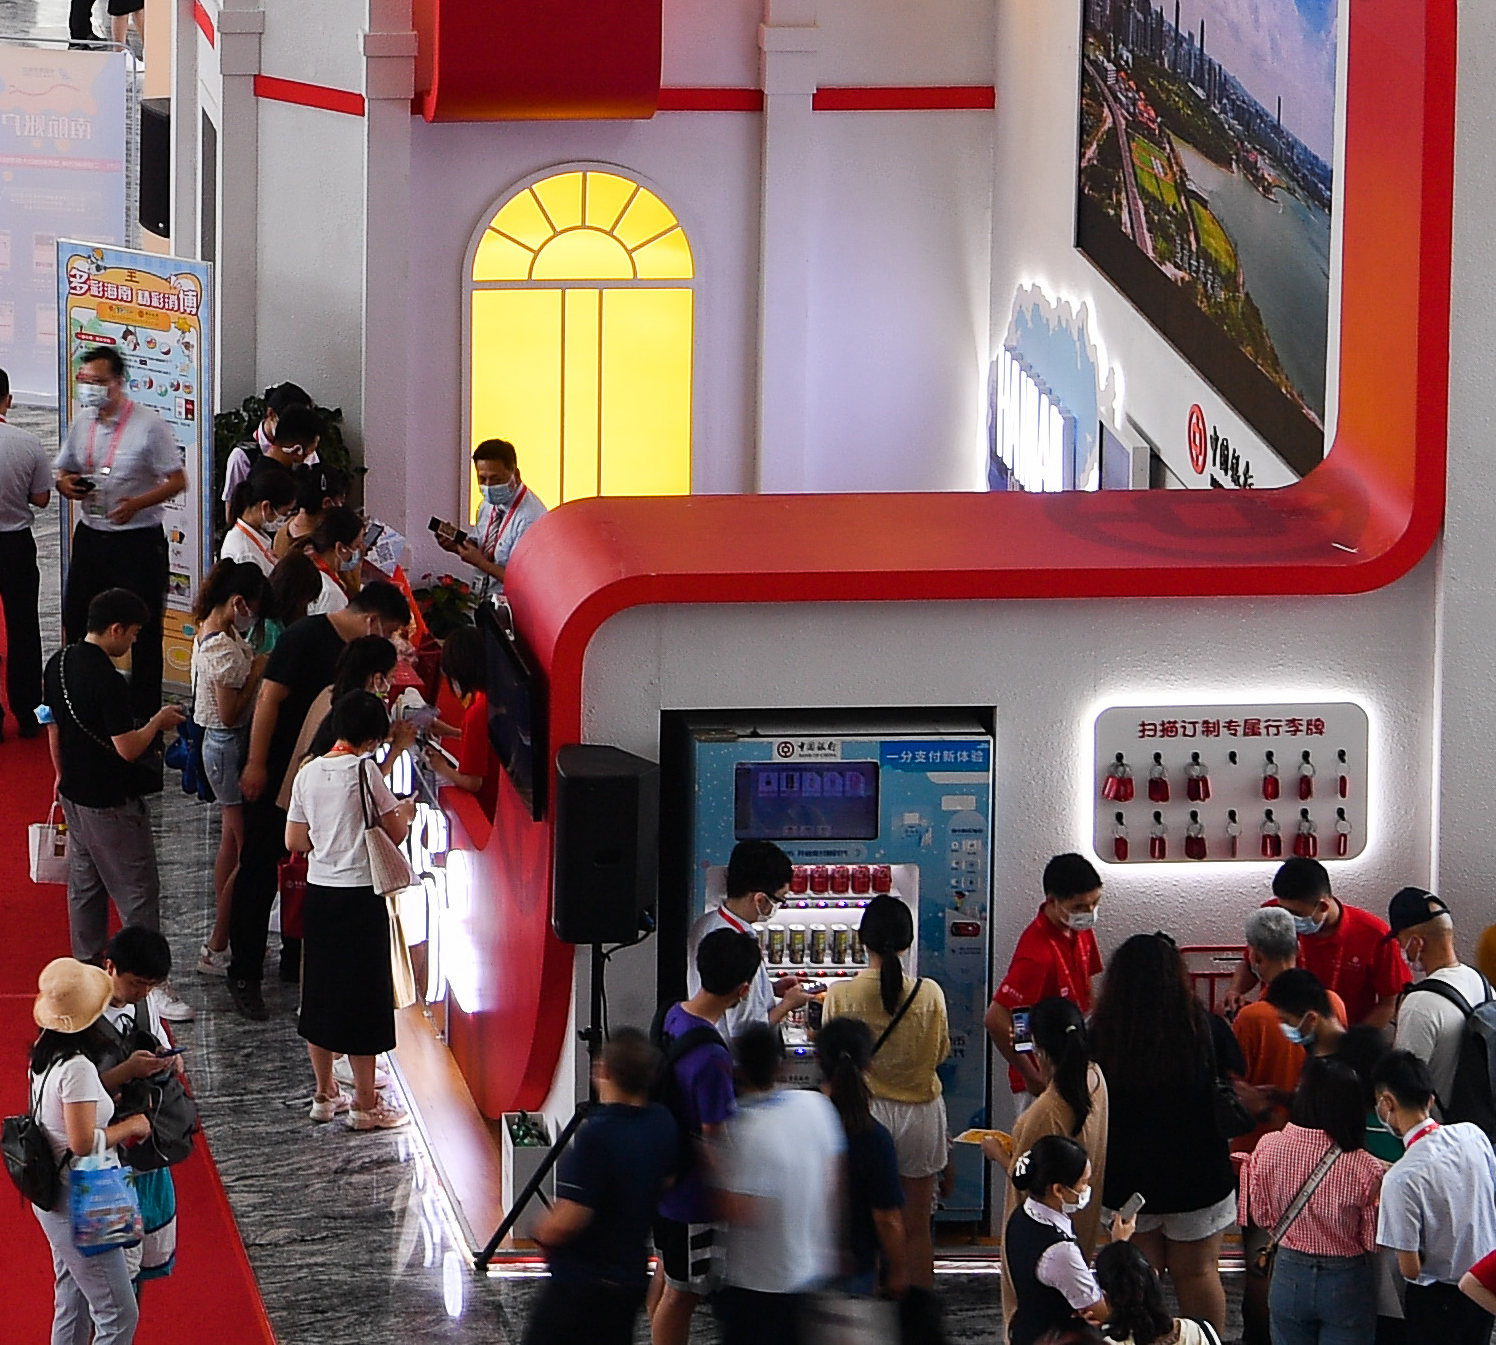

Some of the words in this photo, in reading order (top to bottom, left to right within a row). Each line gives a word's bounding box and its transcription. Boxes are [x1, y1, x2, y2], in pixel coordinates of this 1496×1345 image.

[69, 267, 133, 303] 多彩海南
[136, 289, 199, 316] 精彩消博
[1209, 424, 1254, 488] 中国银行
[1137, 717, 1327, 739] 扫描订制专属行李牌
[797, 740, 837, 754] 中国银行
[886, 749, 985, 764] 一分支付新体验
